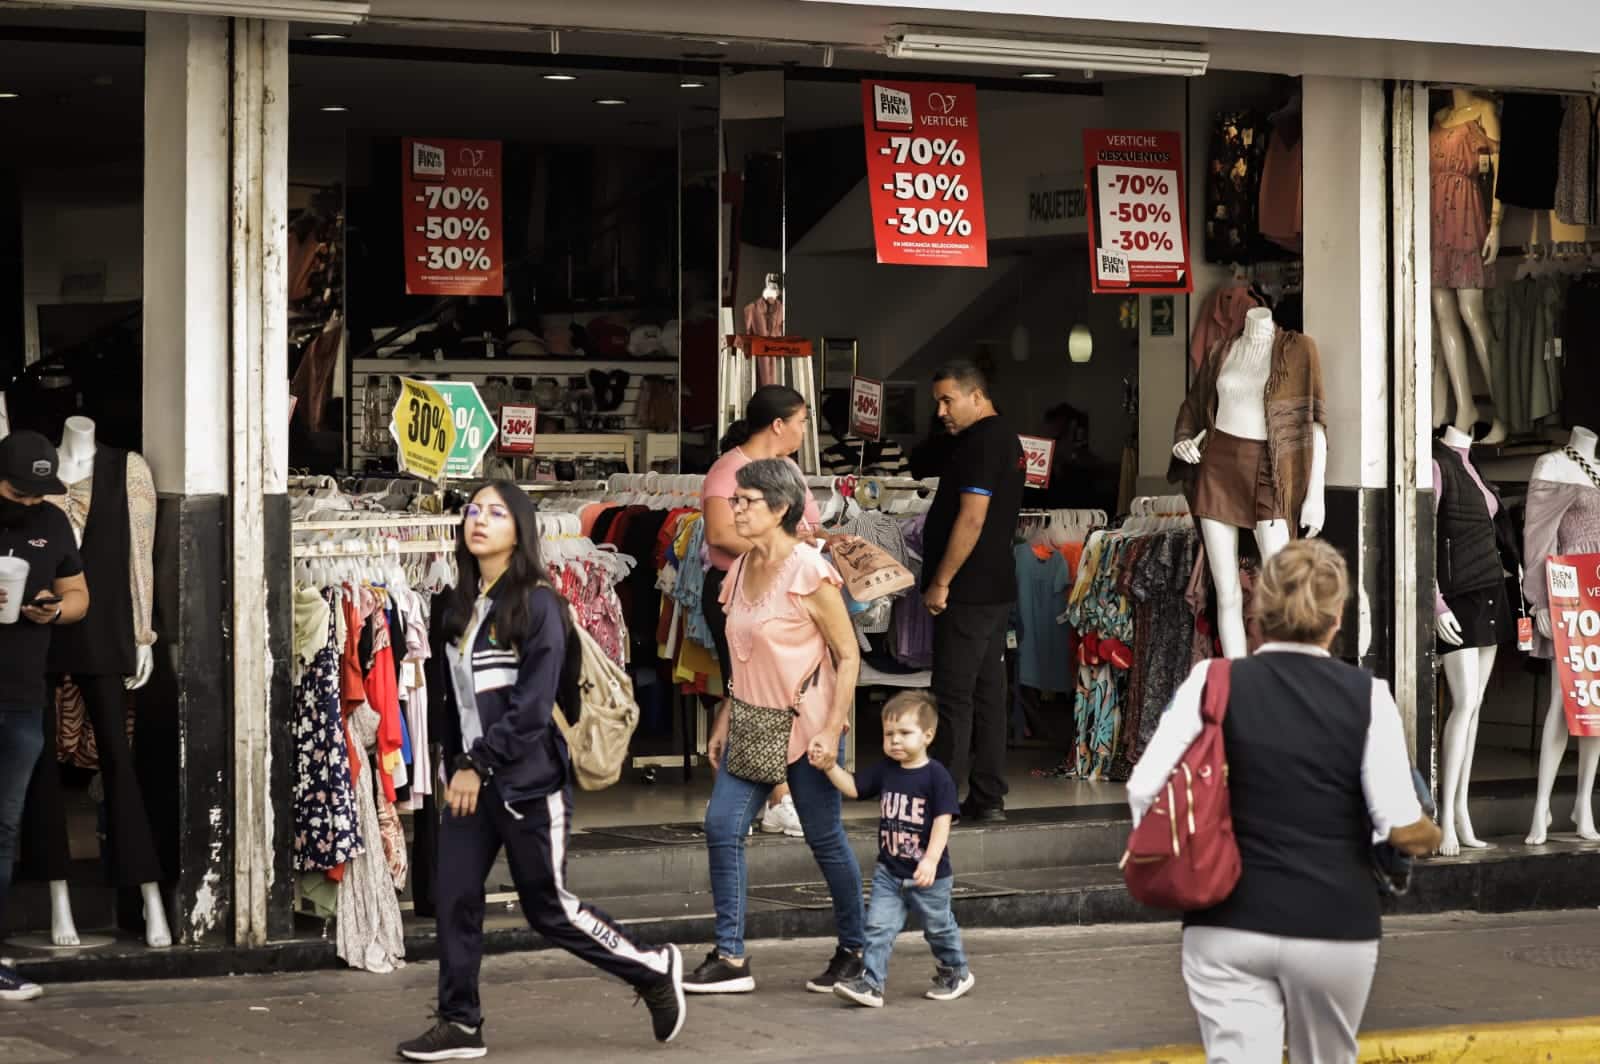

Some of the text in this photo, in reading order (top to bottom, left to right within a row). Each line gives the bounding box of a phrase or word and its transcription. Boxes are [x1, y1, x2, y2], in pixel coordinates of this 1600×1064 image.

[880, 93, 906, 106] BUEN
[881, 103, 900, 115] FIN
[920, 115, 968, 127] VERTICHE
[880, 137, 965, 166] -70%
[1107, 135, 1158, 147] VERTICHE
[1097, 151, 1171, 163] DESCUENTOS
[451, 168, 493, 177] VERTICHE
[883, 172, 969, 201] -50%
[1108, 174, 1169, 195] -70%
[415, 186, 489, 210] -70%
[887, 207, 972, 236] -30%
[1110, 203, 1171, 223] -50%
[416, 216, 490, 240] -50%
[1112, 231, 1173, 251] -30%
[417, 246, 491, 270] -30%
[1102, 255, 1124, 266] BUEN
[1102, 263, 1119, 274] FIN
[408, 398, 446, 453] 30%
[1558, 609, 1600, 638] -70
[1563, 645, 1600, 673] -50
[1570, 680, 1600, 707] -30
[591, 922, 619, 949] UAS
